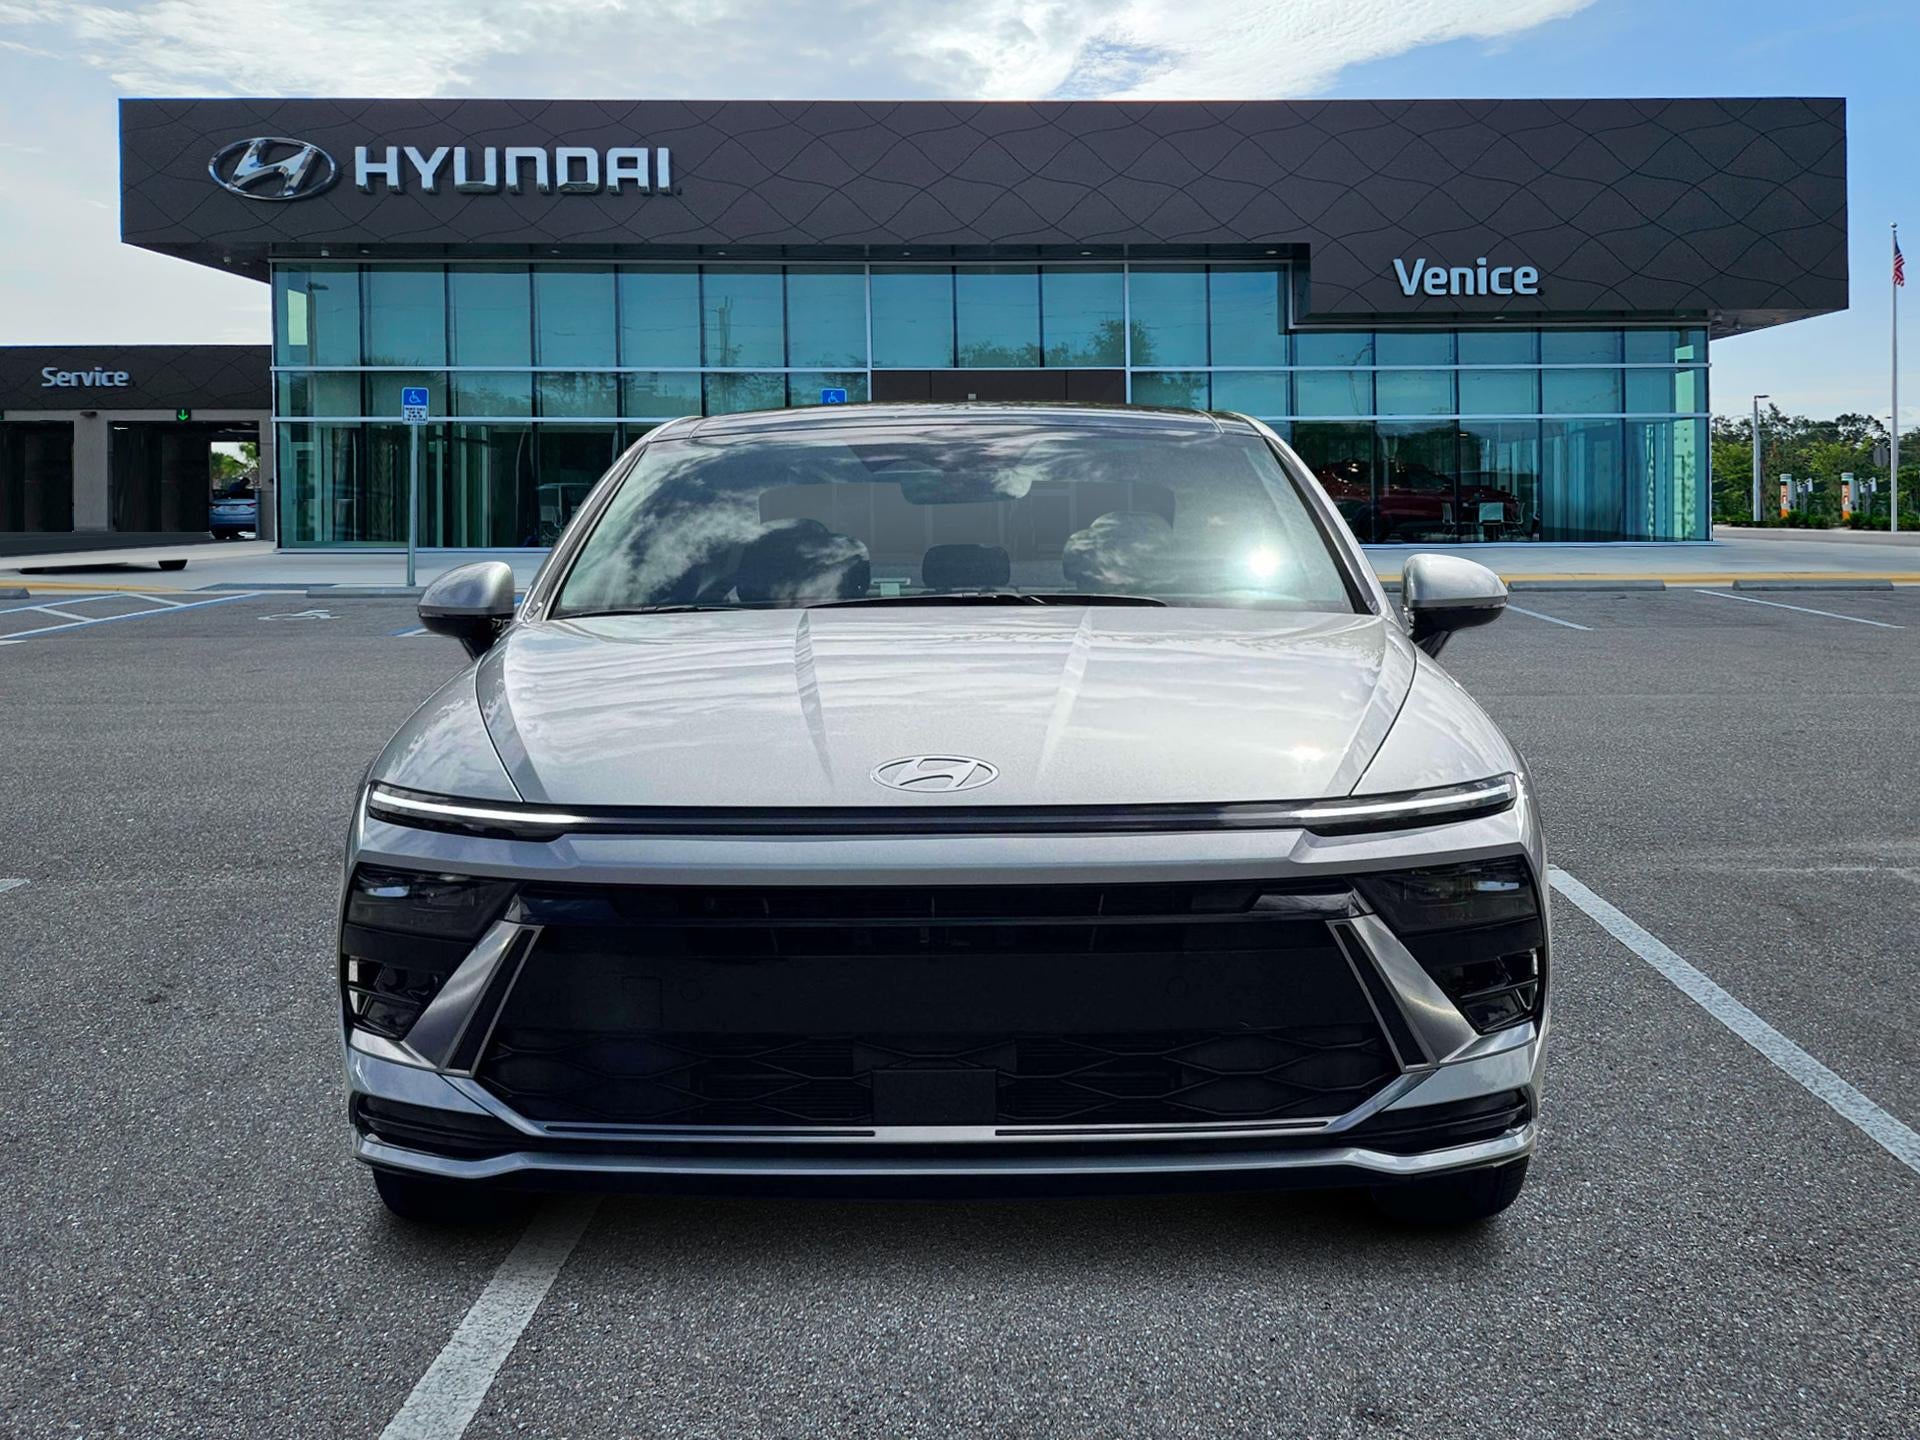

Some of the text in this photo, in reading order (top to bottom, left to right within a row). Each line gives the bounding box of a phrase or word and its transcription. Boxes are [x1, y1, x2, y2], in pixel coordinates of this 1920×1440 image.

[354, 146, 671, 194] HYUNDAI
[1393, 257, 1539, 296] Venice
[41, 366, 130, 387] Service
